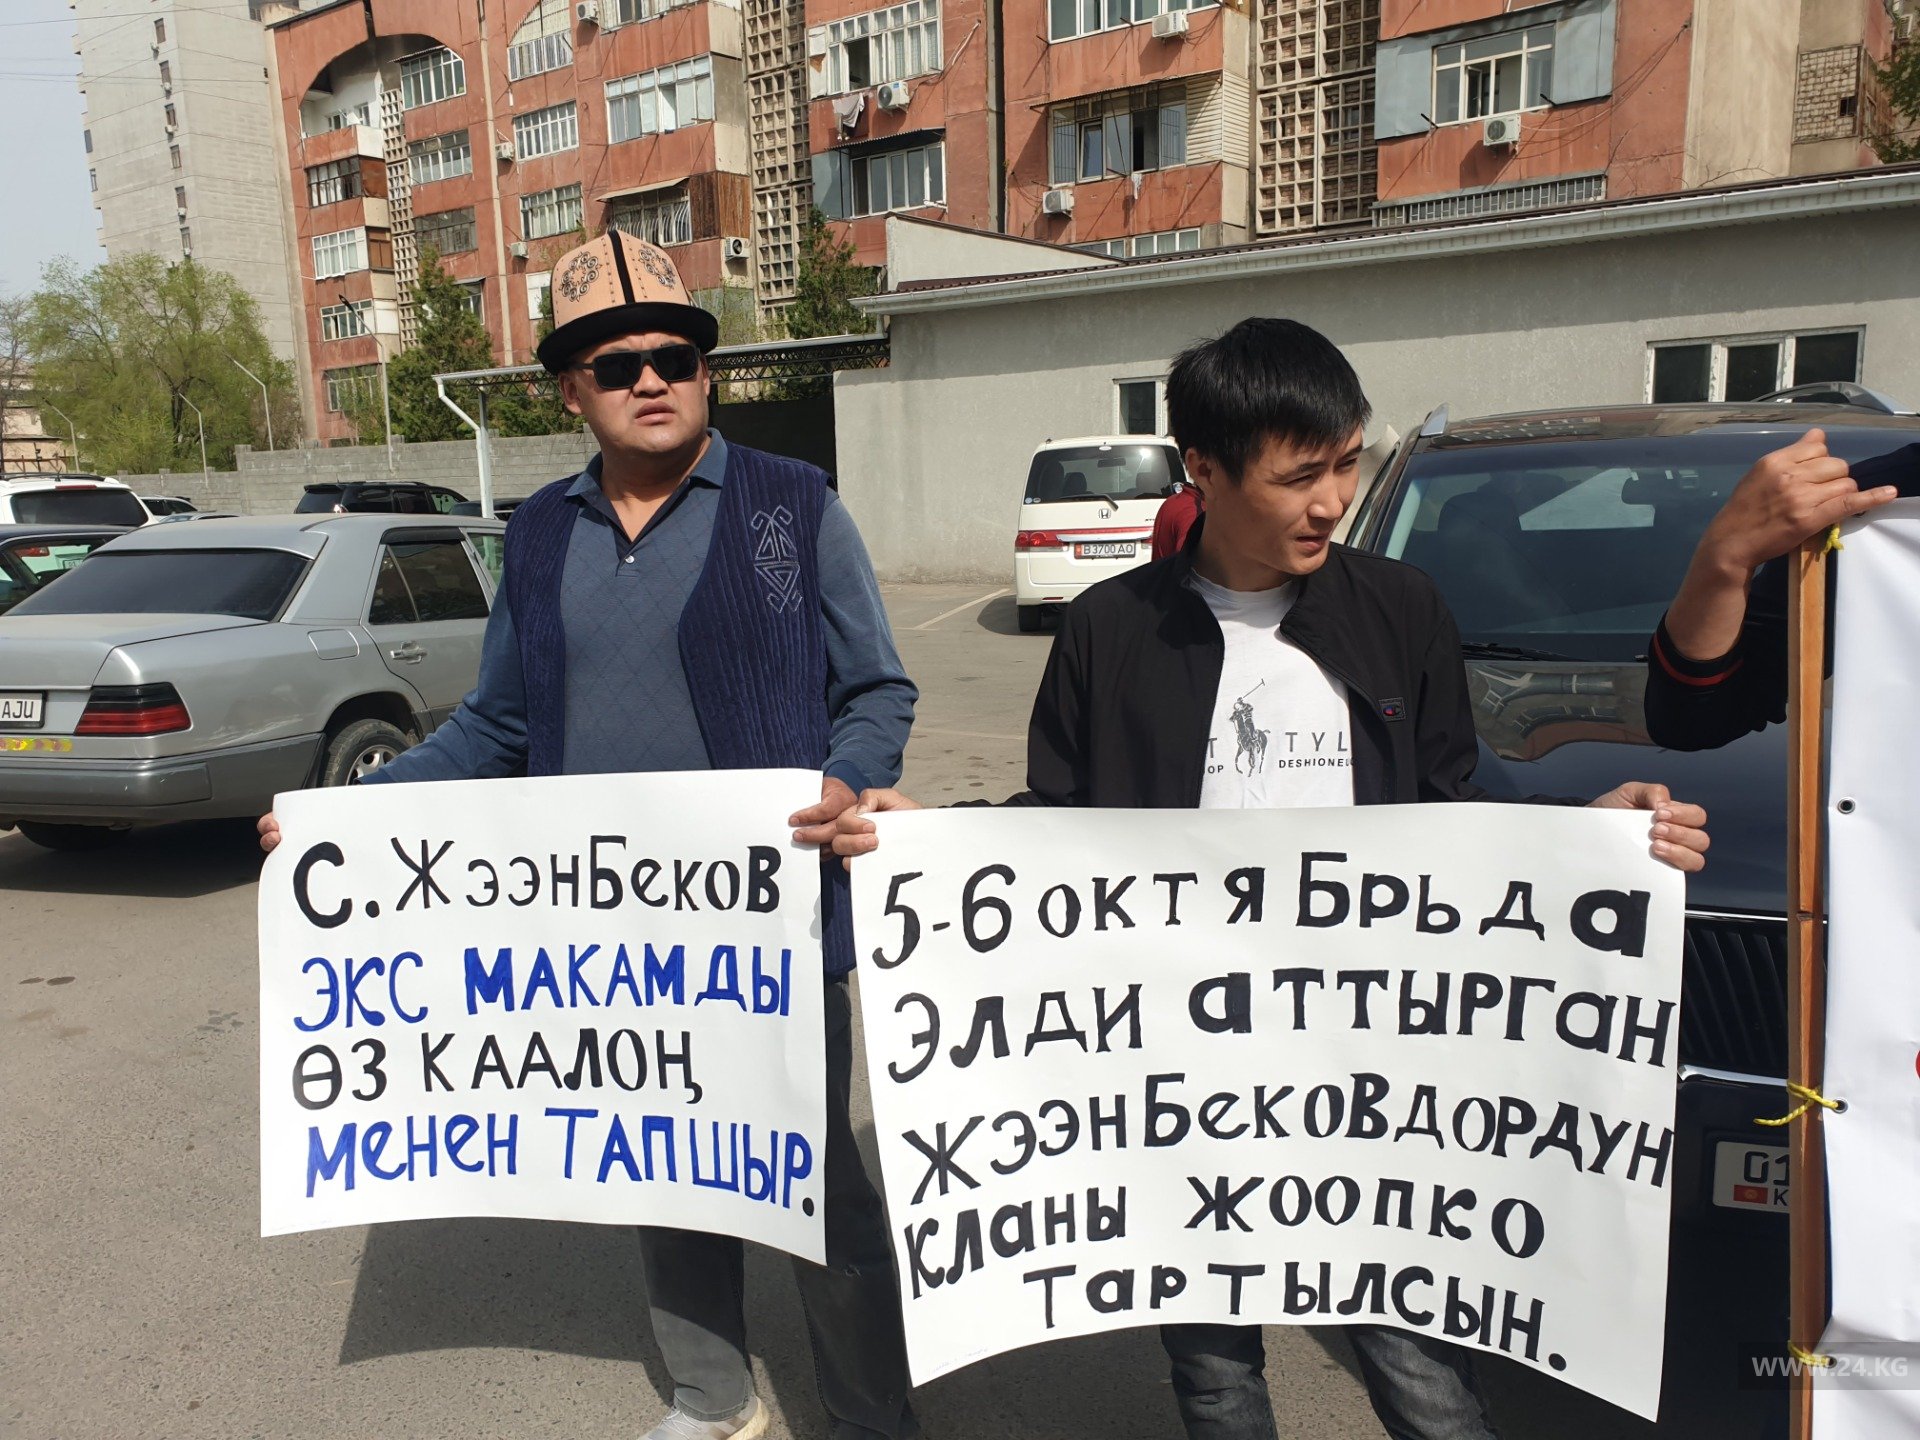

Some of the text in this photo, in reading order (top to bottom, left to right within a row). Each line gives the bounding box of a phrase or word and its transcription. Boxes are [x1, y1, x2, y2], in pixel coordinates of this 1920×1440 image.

[1, 700, 34, 719] AJU
[872, 864, 1016, 969] 5-6
[464, 943, 792, 1017] МАКАМДЫ
[1743, 1150, 1790, 1187] 01
